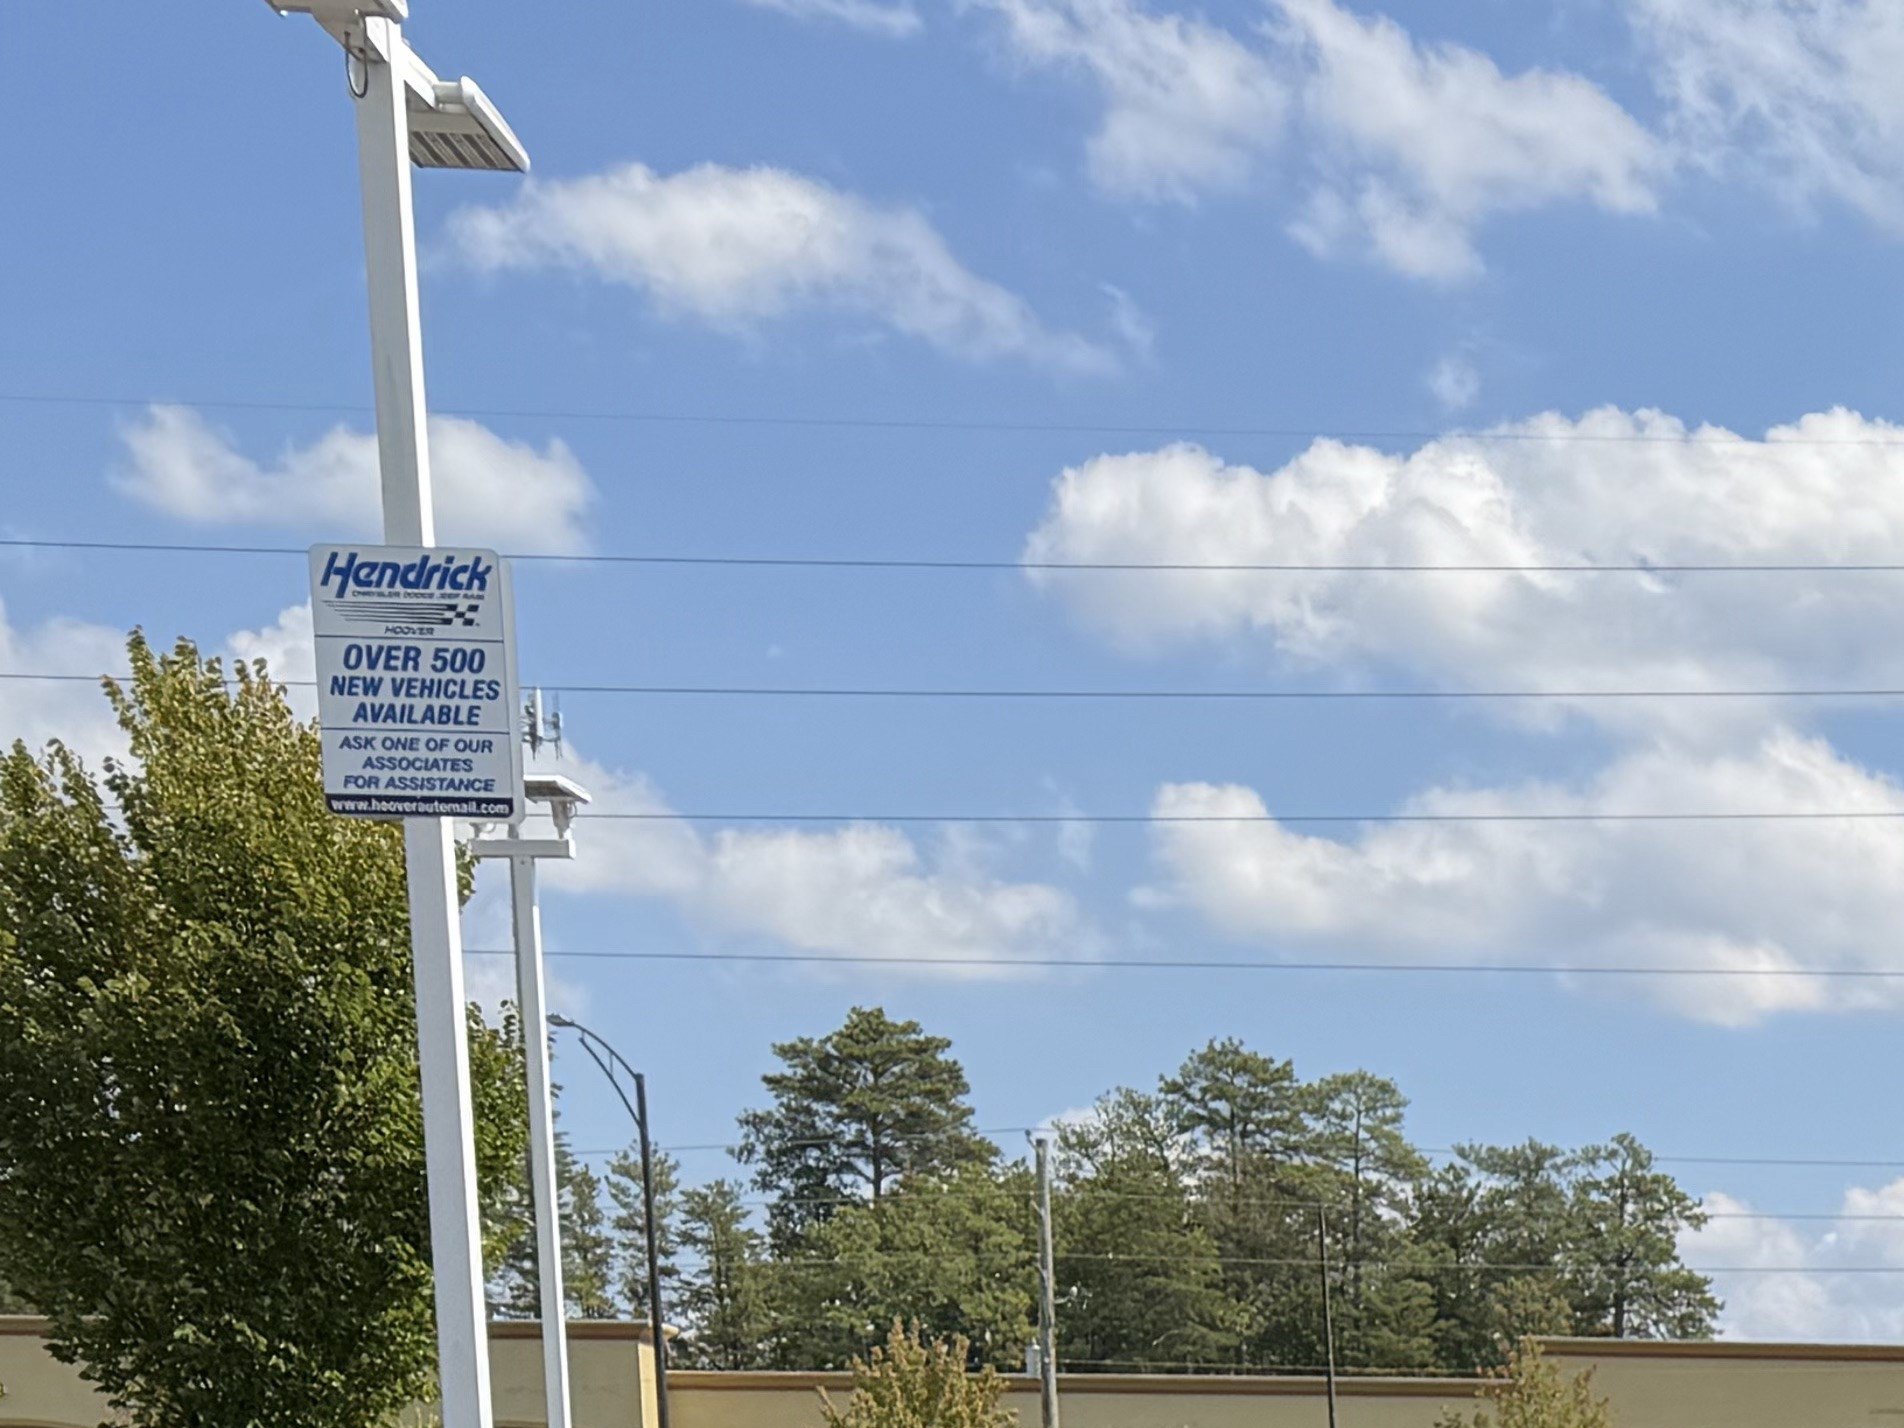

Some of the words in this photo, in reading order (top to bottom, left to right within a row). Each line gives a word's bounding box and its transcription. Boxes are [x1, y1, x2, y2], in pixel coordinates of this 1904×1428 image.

[320, 552, 492, 598] Hendrick
[385, 626, 435, 636] HOOVER
[343, 644, 420, 672] OVER
[431, 648, 485, 674] 500
[330, 676, 383, 697] NEW
[391, 678, 501, 700] VEHICLES
[352, 702, 481, 726] AVAILABLE
[339, 736, 377, 751] ASK
[381, 737, 420, 751] ONE
[425, 738, 449, 752] OF
[454, 739, 493, 753] OUR
[362, 756, 473, 772] ASSOCIATES
[343, 775, 379, 790] FOR
[384, 776, 496, 792] ASSISTANCE
